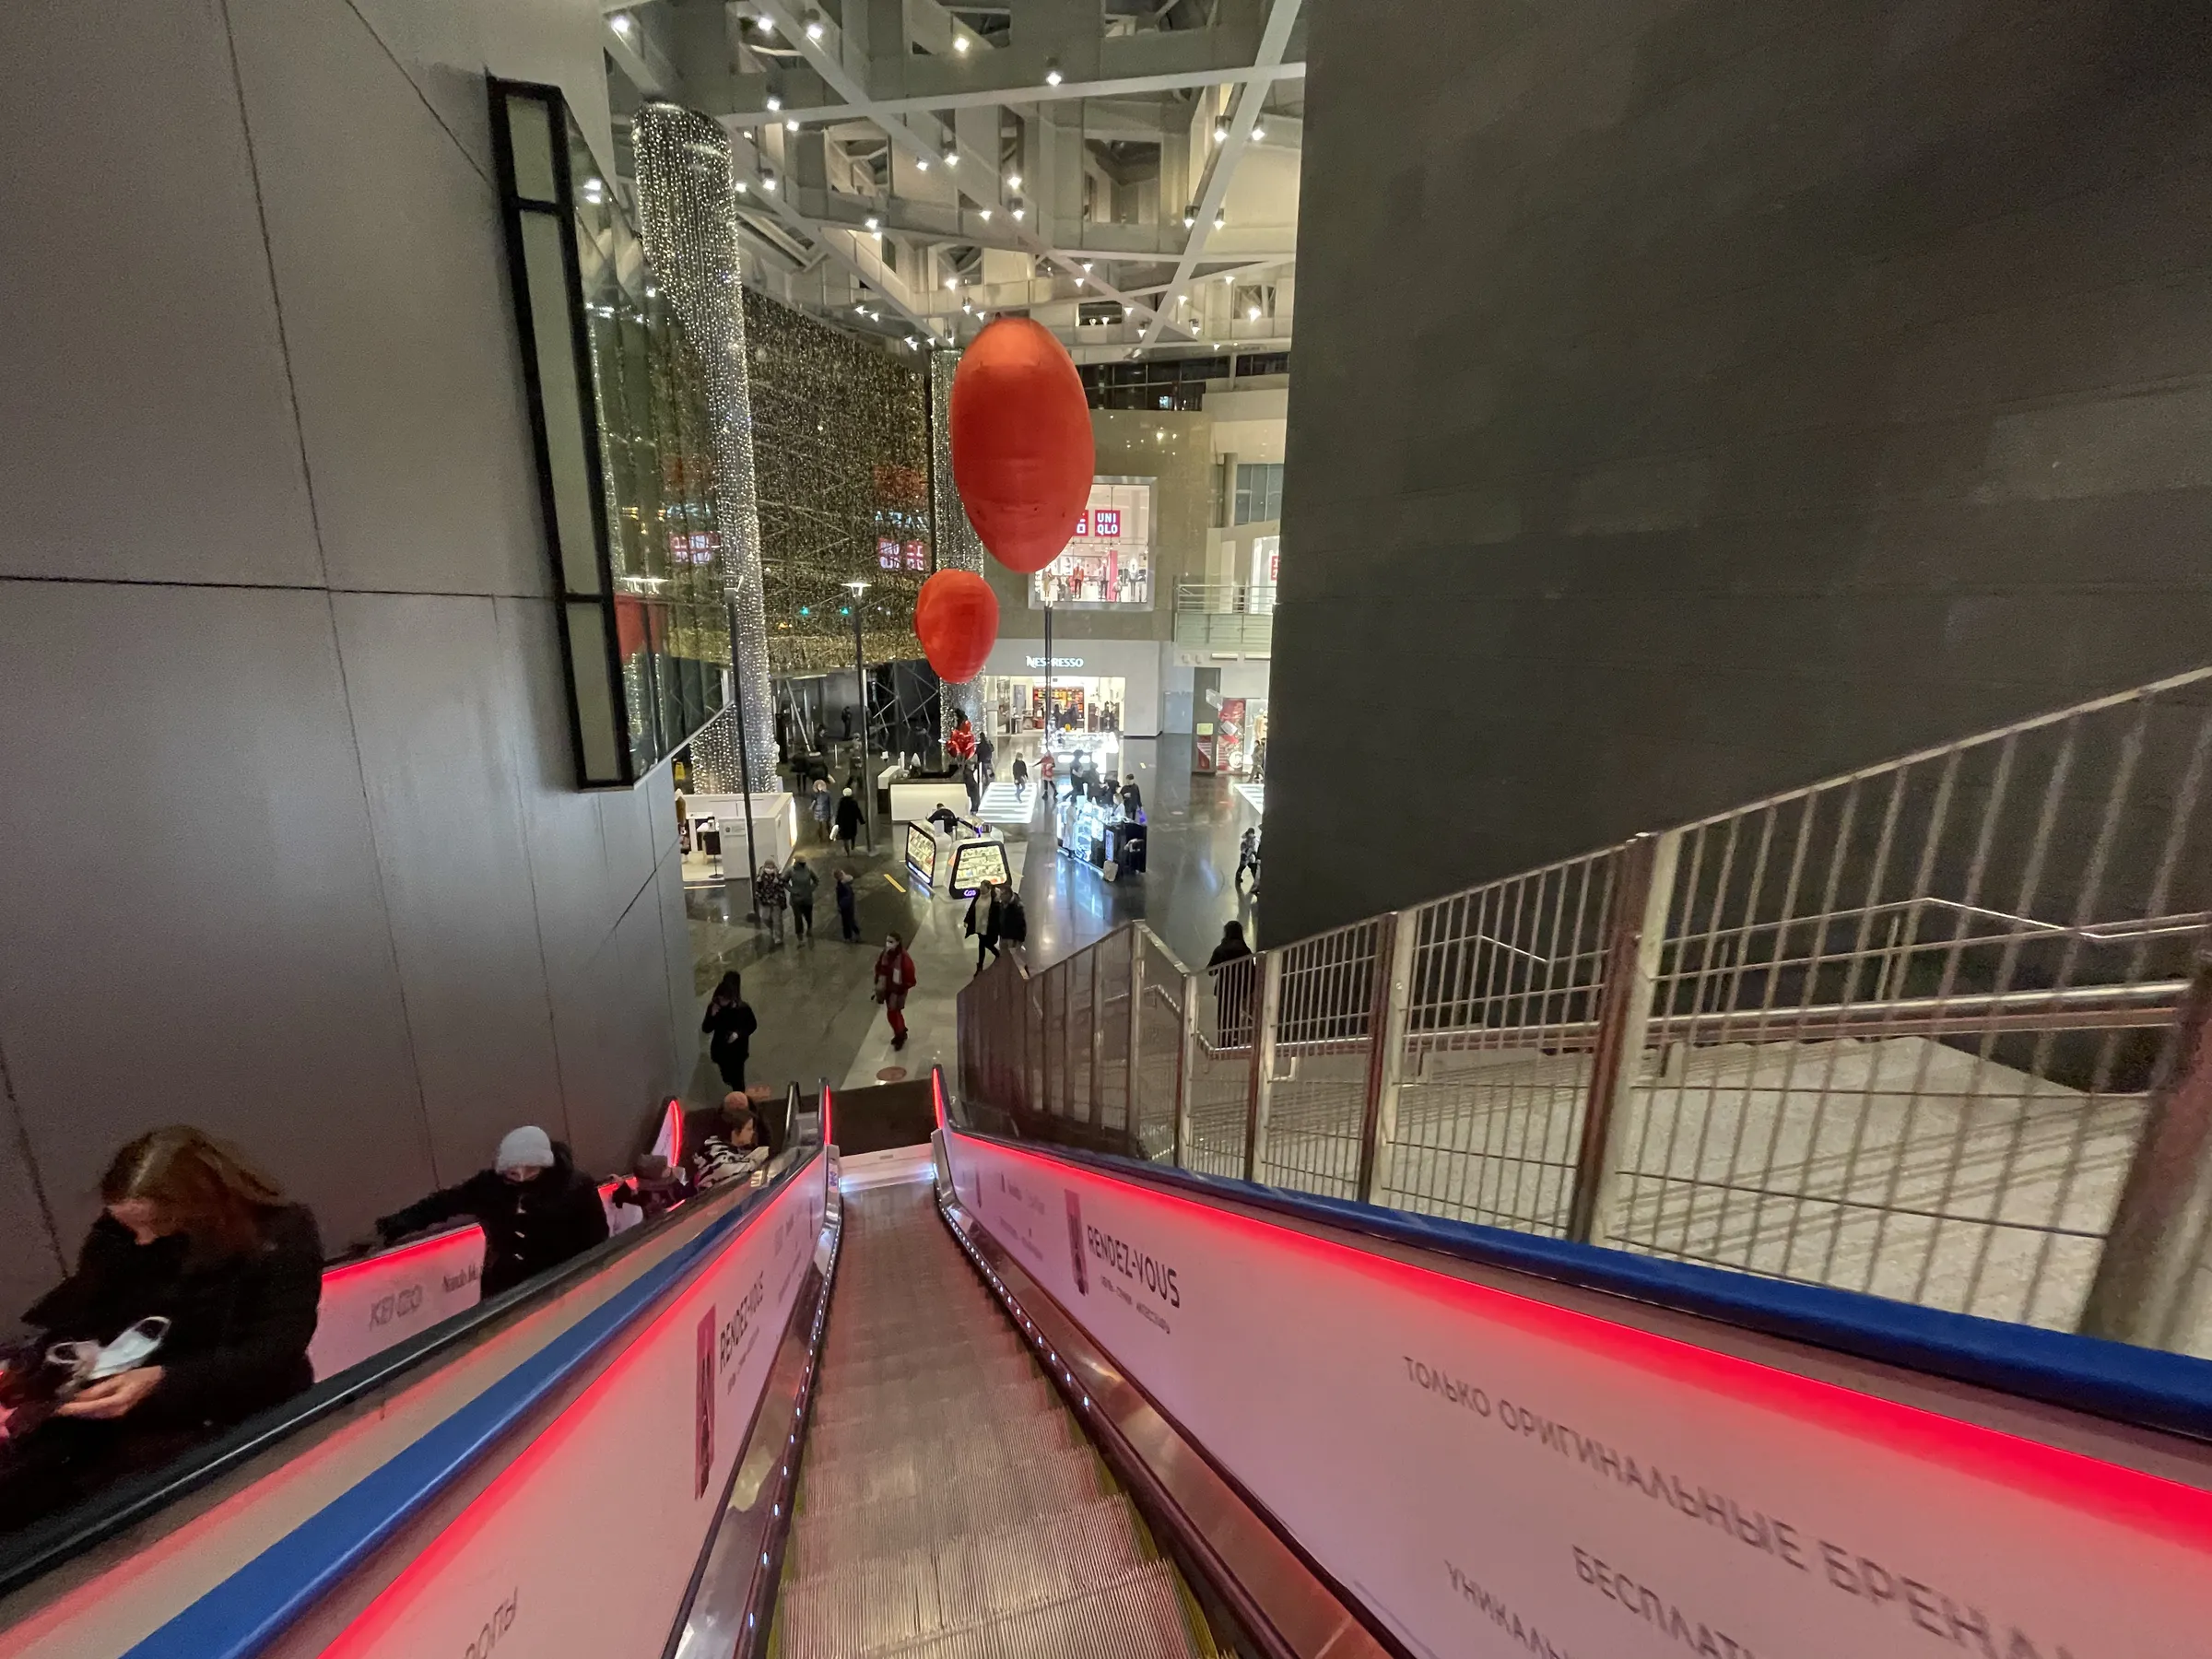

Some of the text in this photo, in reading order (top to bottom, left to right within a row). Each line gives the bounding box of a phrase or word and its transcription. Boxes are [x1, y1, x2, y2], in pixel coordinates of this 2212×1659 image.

[1097, 512, 1116, 524] UNI
[1097, 524, 1118, 535] QLO
[1025, 655, 1084, 668] NESRESSO
[1087, 1225, 1181, 1309] RENDEZ-VOUS
[1402, 1355, 2075, 1659] ТОЛЬКО ОРИГИНАЛЬНЫЕ БРЕН
[1571, 1544, 1758, 1659] БЕСПЛАТ
